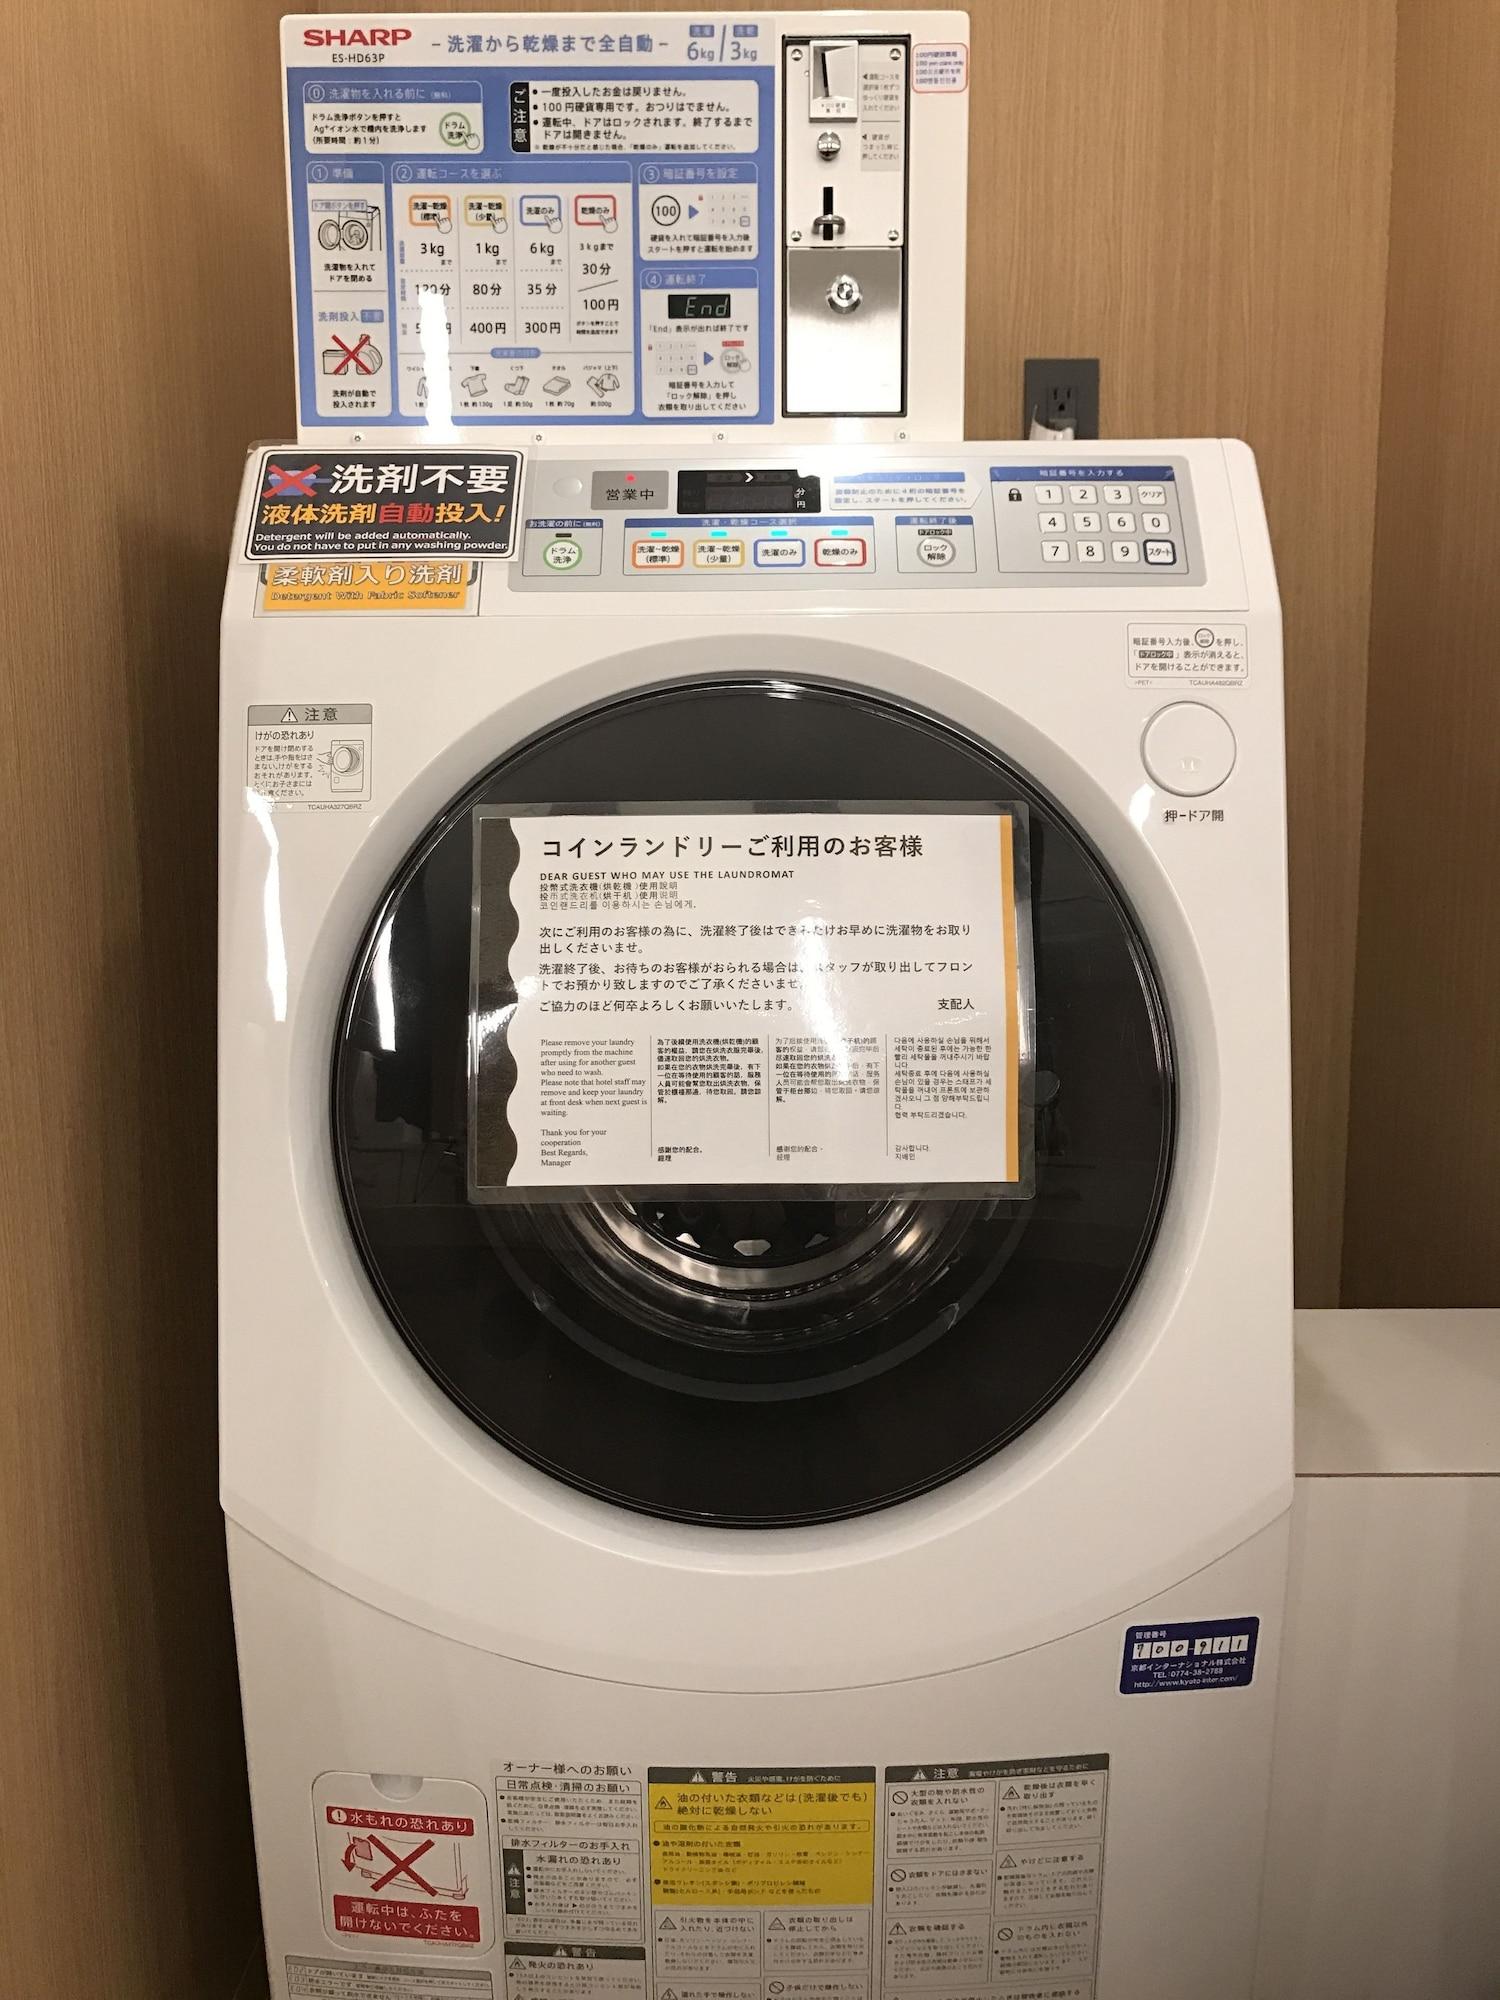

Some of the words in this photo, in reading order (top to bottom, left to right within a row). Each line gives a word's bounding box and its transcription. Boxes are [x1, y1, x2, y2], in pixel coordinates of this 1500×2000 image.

[304, 29, 412, 46] SHARP
[448, 34, 653, 53] 洗濯から乾燥まで全自動
[332, 54, 385, 63] ES-HD63P
[542, 88, 687, 97] 一度投入したお金は戻りません。
[312, 113, 401, 121] ドラム洗浄ボタンを押すと
[514, 88, 527, 143] ご注意
[542, 117, 753, 128] 運転中、ドアはロックされます。終了するまで
[544, 130, 627, 140] ドアは開きません。
[417, 168, 503, 179] 運転コースを選ぶ
[656, 206, 676, 217] 100
[582, 263, 611, 275] 30分
[473, 284, 501, 296] 80分
[527, 284, 557, 295] 35分
[584, 299, 619, 310] 100円
[686, 297, 727, 316] End
[319, 312, 359, 322] 洗剤投入
[470, 323, 506, 334] 400円
[525, 322, 561, 334] 300円
[329, 464, 510, 494] 洗剤不要
[606, 489, 654, 501] 営業中
[1046, 490, 1051, 498] 1
[1079, 490, 1087, 499] 2
[1114, 490, 1122, 499] 3
[797, 501, 805, 509] 円
[261, 503, 505, 524] 液体洗剤自動投入!
[1048, 518, 1057, 527] 4
[1083, 517, 1091, 527] 5
[1117, 517, 1126, 527] 6
[1152, 518, 1160, 527] 0
[256, 533, 312, 542] Detergent
[315, 532, 334, 540] will
[338, 532, 351, 540] be
[355, 532, 389, 540] added
[393, 532, 471, 540] automatically.
[277, 543, 291, 551] do
[415, 541, 461, 550] washing
[464, 542, 508, 550] powder.
[924, 544, 948, 552] ロック
[1052, 546, 1059, 556] 7
[1086, 546, 1094, 556] 8
[1121, 546, 1129, 556] 9
[762, 549, 797, 557] 洗濯のみ
[927, 553, 946, 561] 解除
[273, 564, 461, 585] 柔軟剤入り洗剤
[271, 592, 332, 601] Detergent
[368, 591, 404, 599] Fabric
[1135, 663, 1244, 672] ドアを開けることができます。
[305, 708, 338, 721] 注意
[255, 731, 314, 740] けがの恐れあり
[544, 835, 923, 858] コインランドリーご利用のお客様
[540, 873, 568, 881] DEAR
[573, 872, 606, 880] GUEST
[642, 871, 664, 879] MAY
[670, 871, 689, 879] USE
[718, 870, 794, 879] LAUNDROMAT
[602, 901, 650, 909] 이용하시는
[655, 900, 696, 909] 손님에게.
[540, 943, 644, 954] 出しくださいませ。
[539, 999, 793, 1012] ご協力のほど何卒よろしくお願いいたします。
[938, 999, 974, 1010] 支配人
[609, 1039, 634, 1047] laundry
[541, 1049, 571, 1057] promptly
[618, 1088, 643, 1096] laundry
[1136, 1631, 1167, 1639] 管理番号
[1131, 1657, 1246, 1672] 京都インターナショナル株式会社
[504, 1762, 631, 1776] オーナー様へのお願い
[934, 1768, 959, 1778] 注意
[712, 1772, 737, 1783] 警告
[677, 1793, 868, 1803] 油の付いた衣類などは(洗濯後でも)
[911, 1797, 968, 1805] 衣類を入れない
[677, 1806, 772, 1815] 絶対に乾燥しない
[351, 1813, 467, 1832] 水もれの恐れあり
[511, 1838, 630, 1851] 排水フィルターのお手入れ
[536, 1855, 621, 1865] 水漏れの恐れあり
[351, 1902, 462, 1921] 運転中は、ふたを
[340, 1916, 474, 1938] 開けないでください。
[529, 1962, 594, 1970] 発火の恐れあり
